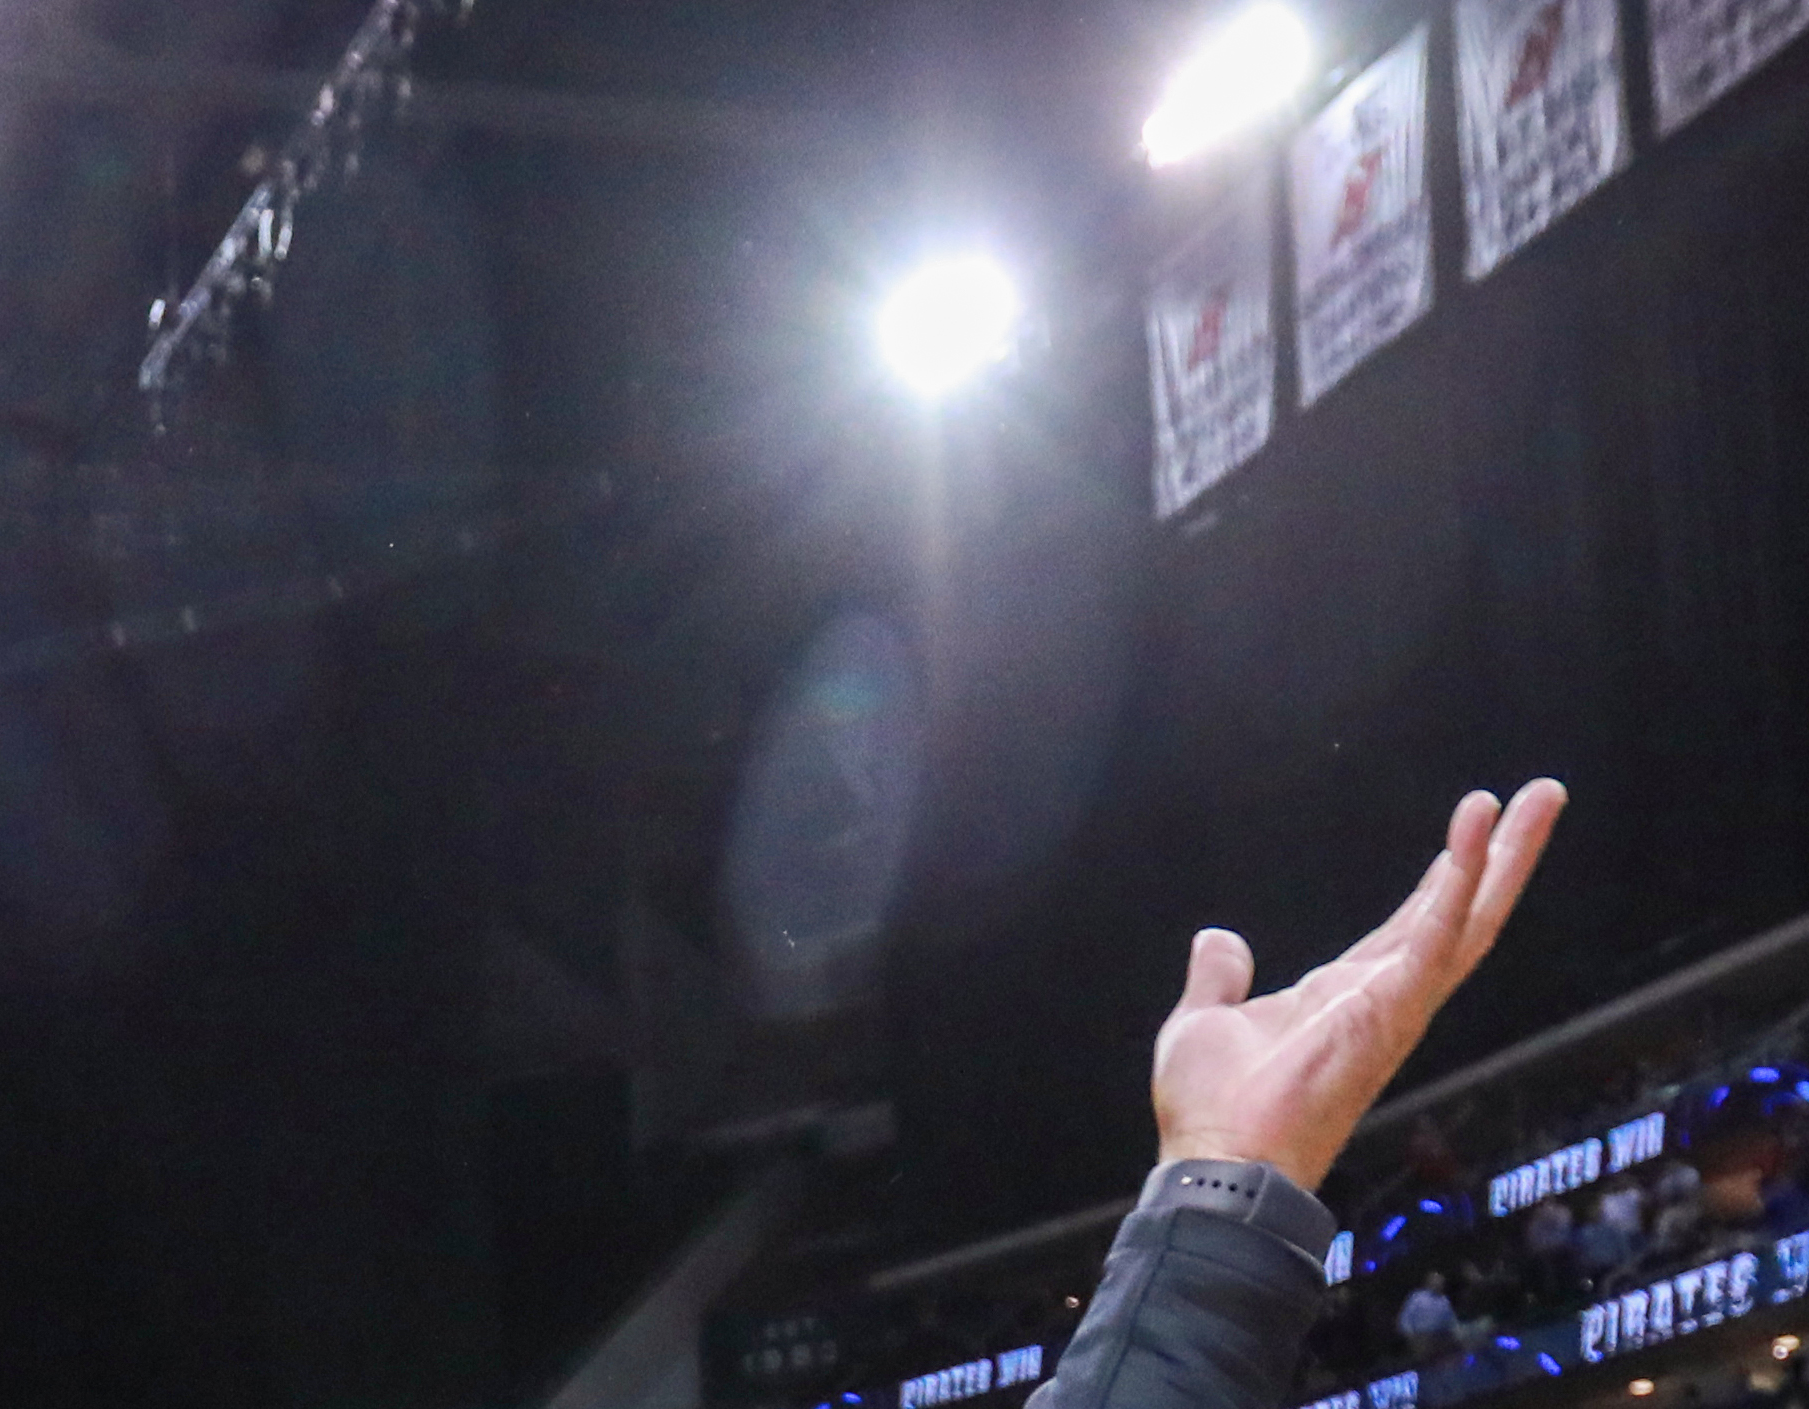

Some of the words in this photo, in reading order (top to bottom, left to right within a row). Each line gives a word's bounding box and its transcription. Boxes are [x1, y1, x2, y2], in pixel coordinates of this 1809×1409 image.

[1490, 1138, 1603, 1218] PIRATES
[1607, 1111, 1666, 1174] WIN
[1580, 1252, 1759, 1363] PIRATES
[997, 1344, 1043, 1388] WIN
